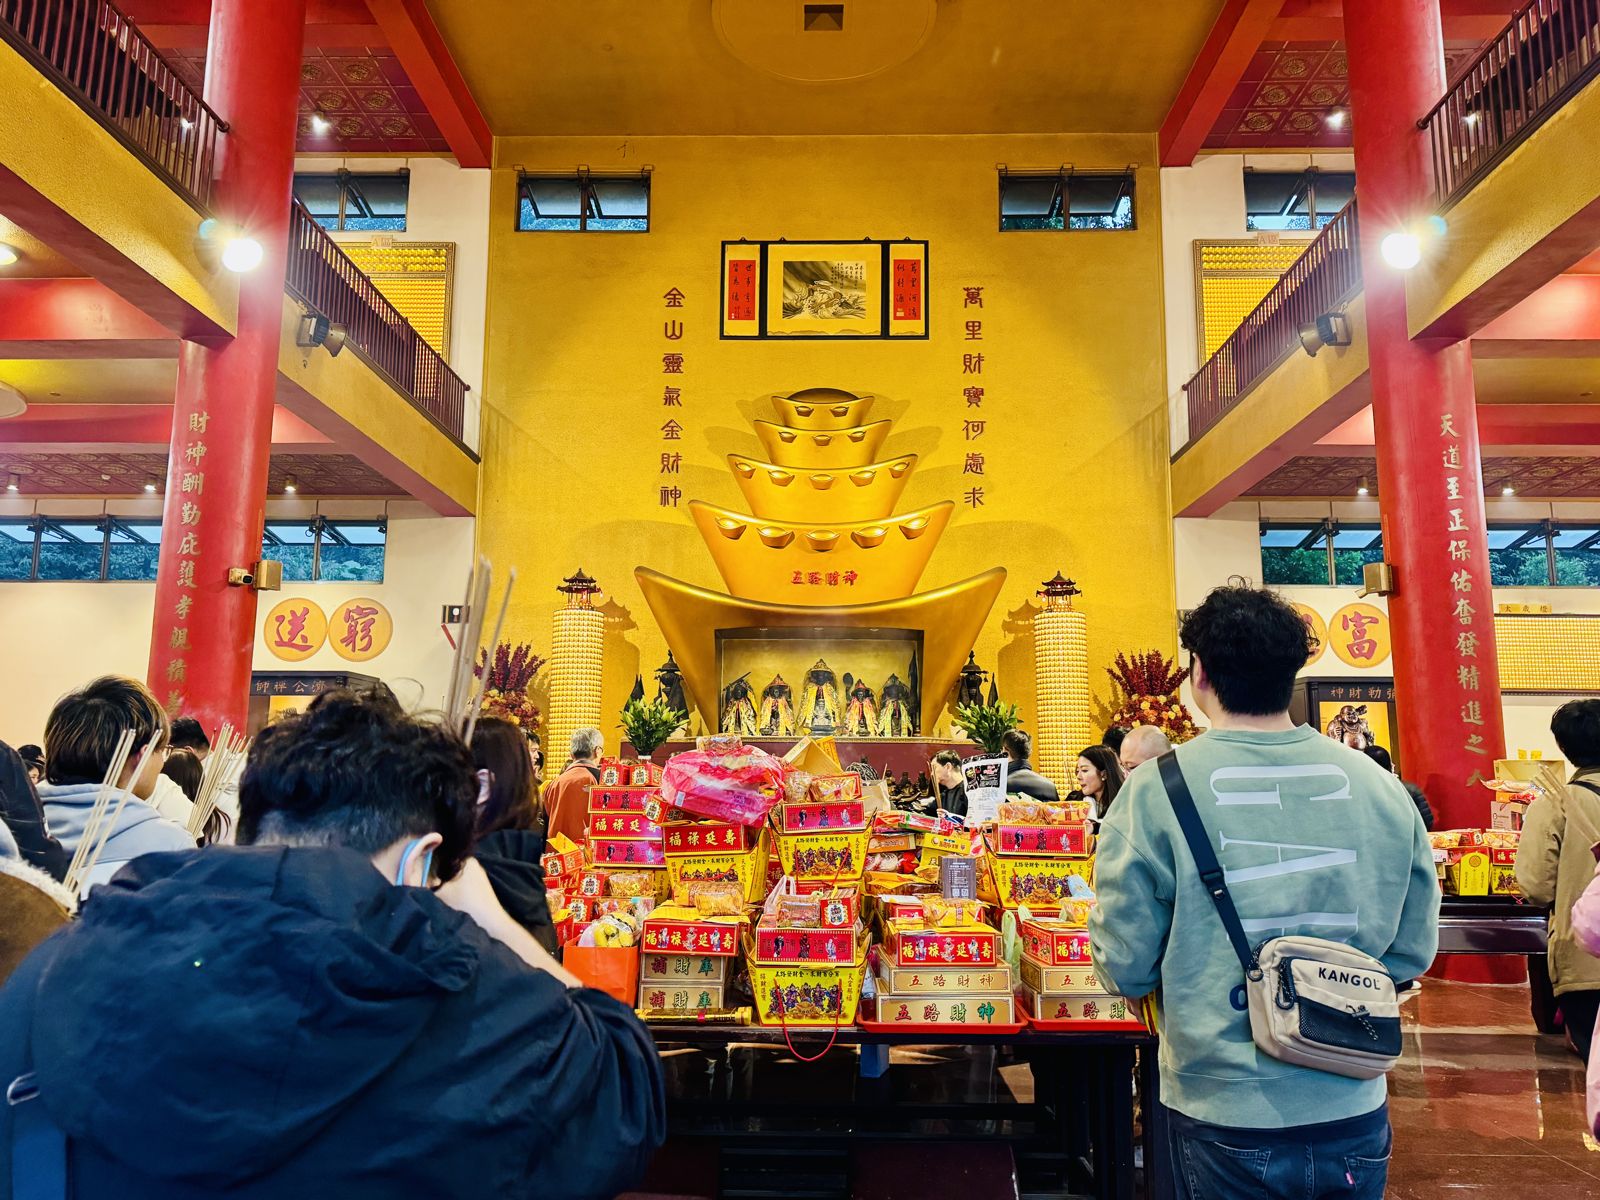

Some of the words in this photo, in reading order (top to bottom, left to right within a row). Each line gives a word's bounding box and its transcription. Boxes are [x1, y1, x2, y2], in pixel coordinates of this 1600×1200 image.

[659, 287, 685, 508] 金山靈氣金財神
[962, 287, 986, 509] 萬里財寶何處求
[791, 570, 858, 586] 五路財神
[669, 829, 736, 847] 福祿延壽
[645, 931, 735, 949] 福祿延壽
[902, 941, 993, 960] 福祿延壽
[909, 974, 995, 988] 五路財神
[1318, 966, 1381, 991] KANGOL
[894, 1002, 996, 1024] 五路財神
